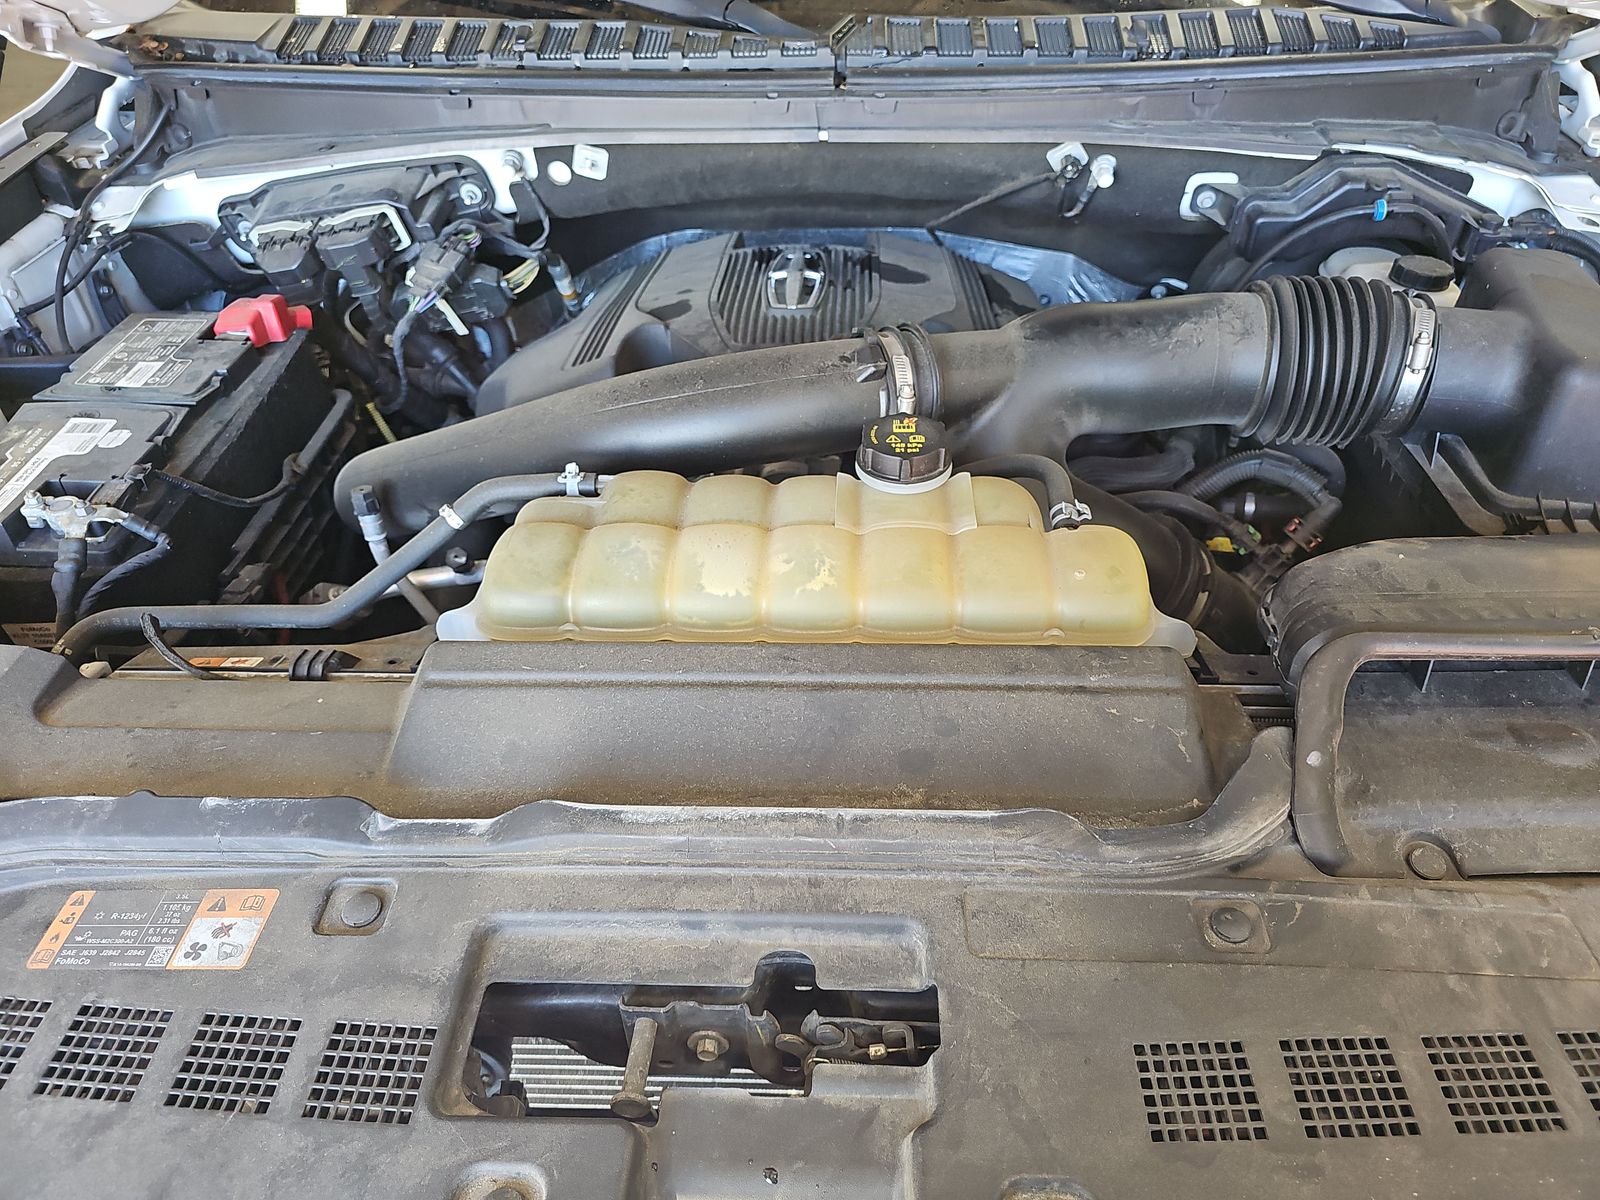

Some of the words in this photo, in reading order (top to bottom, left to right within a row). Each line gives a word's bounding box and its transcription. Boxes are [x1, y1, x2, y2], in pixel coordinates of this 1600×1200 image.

[182, 904, 192, 912] kg
[110, 912, 147, 921] R-1234yf
[120, 929, 139, 937] PAG
[162, 936, 175, 944] cc)
[55, 957, 91, 965] FoMoCo
